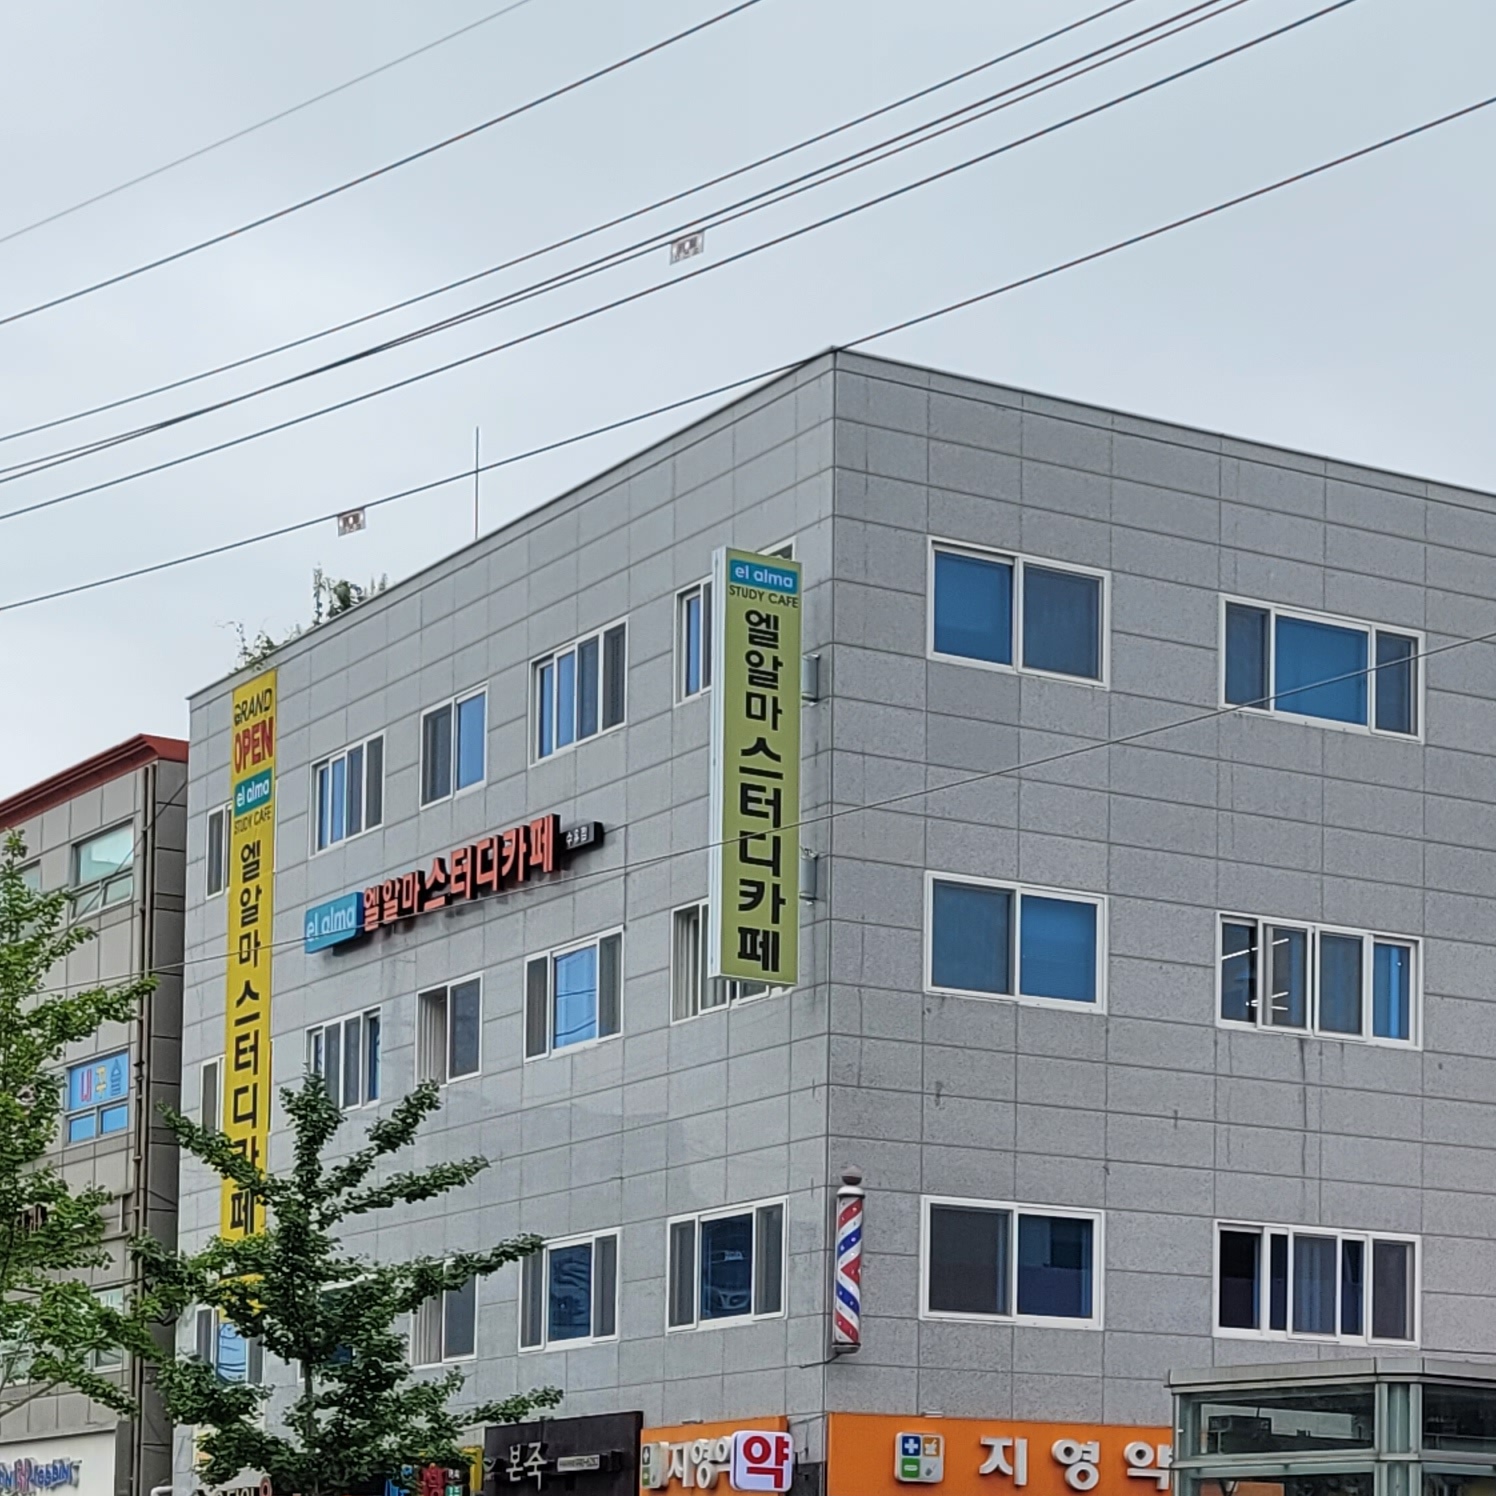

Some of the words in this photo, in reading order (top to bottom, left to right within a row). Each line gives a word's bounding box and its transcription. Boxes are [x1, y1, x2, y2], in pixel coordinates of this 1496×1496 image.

[729, 585, 765, 602] STUDY
[768, 593, 799, 609] CAFE
[735, 565, 749, 579] el
[753, 569, 793, 588] alma
[234, 688, 273, 726] GRAND
[234, 716, 275, 774] OPEN
[505, 1441, 548, 1491] 본죽
[742, 1435, 790, 1489] 약
